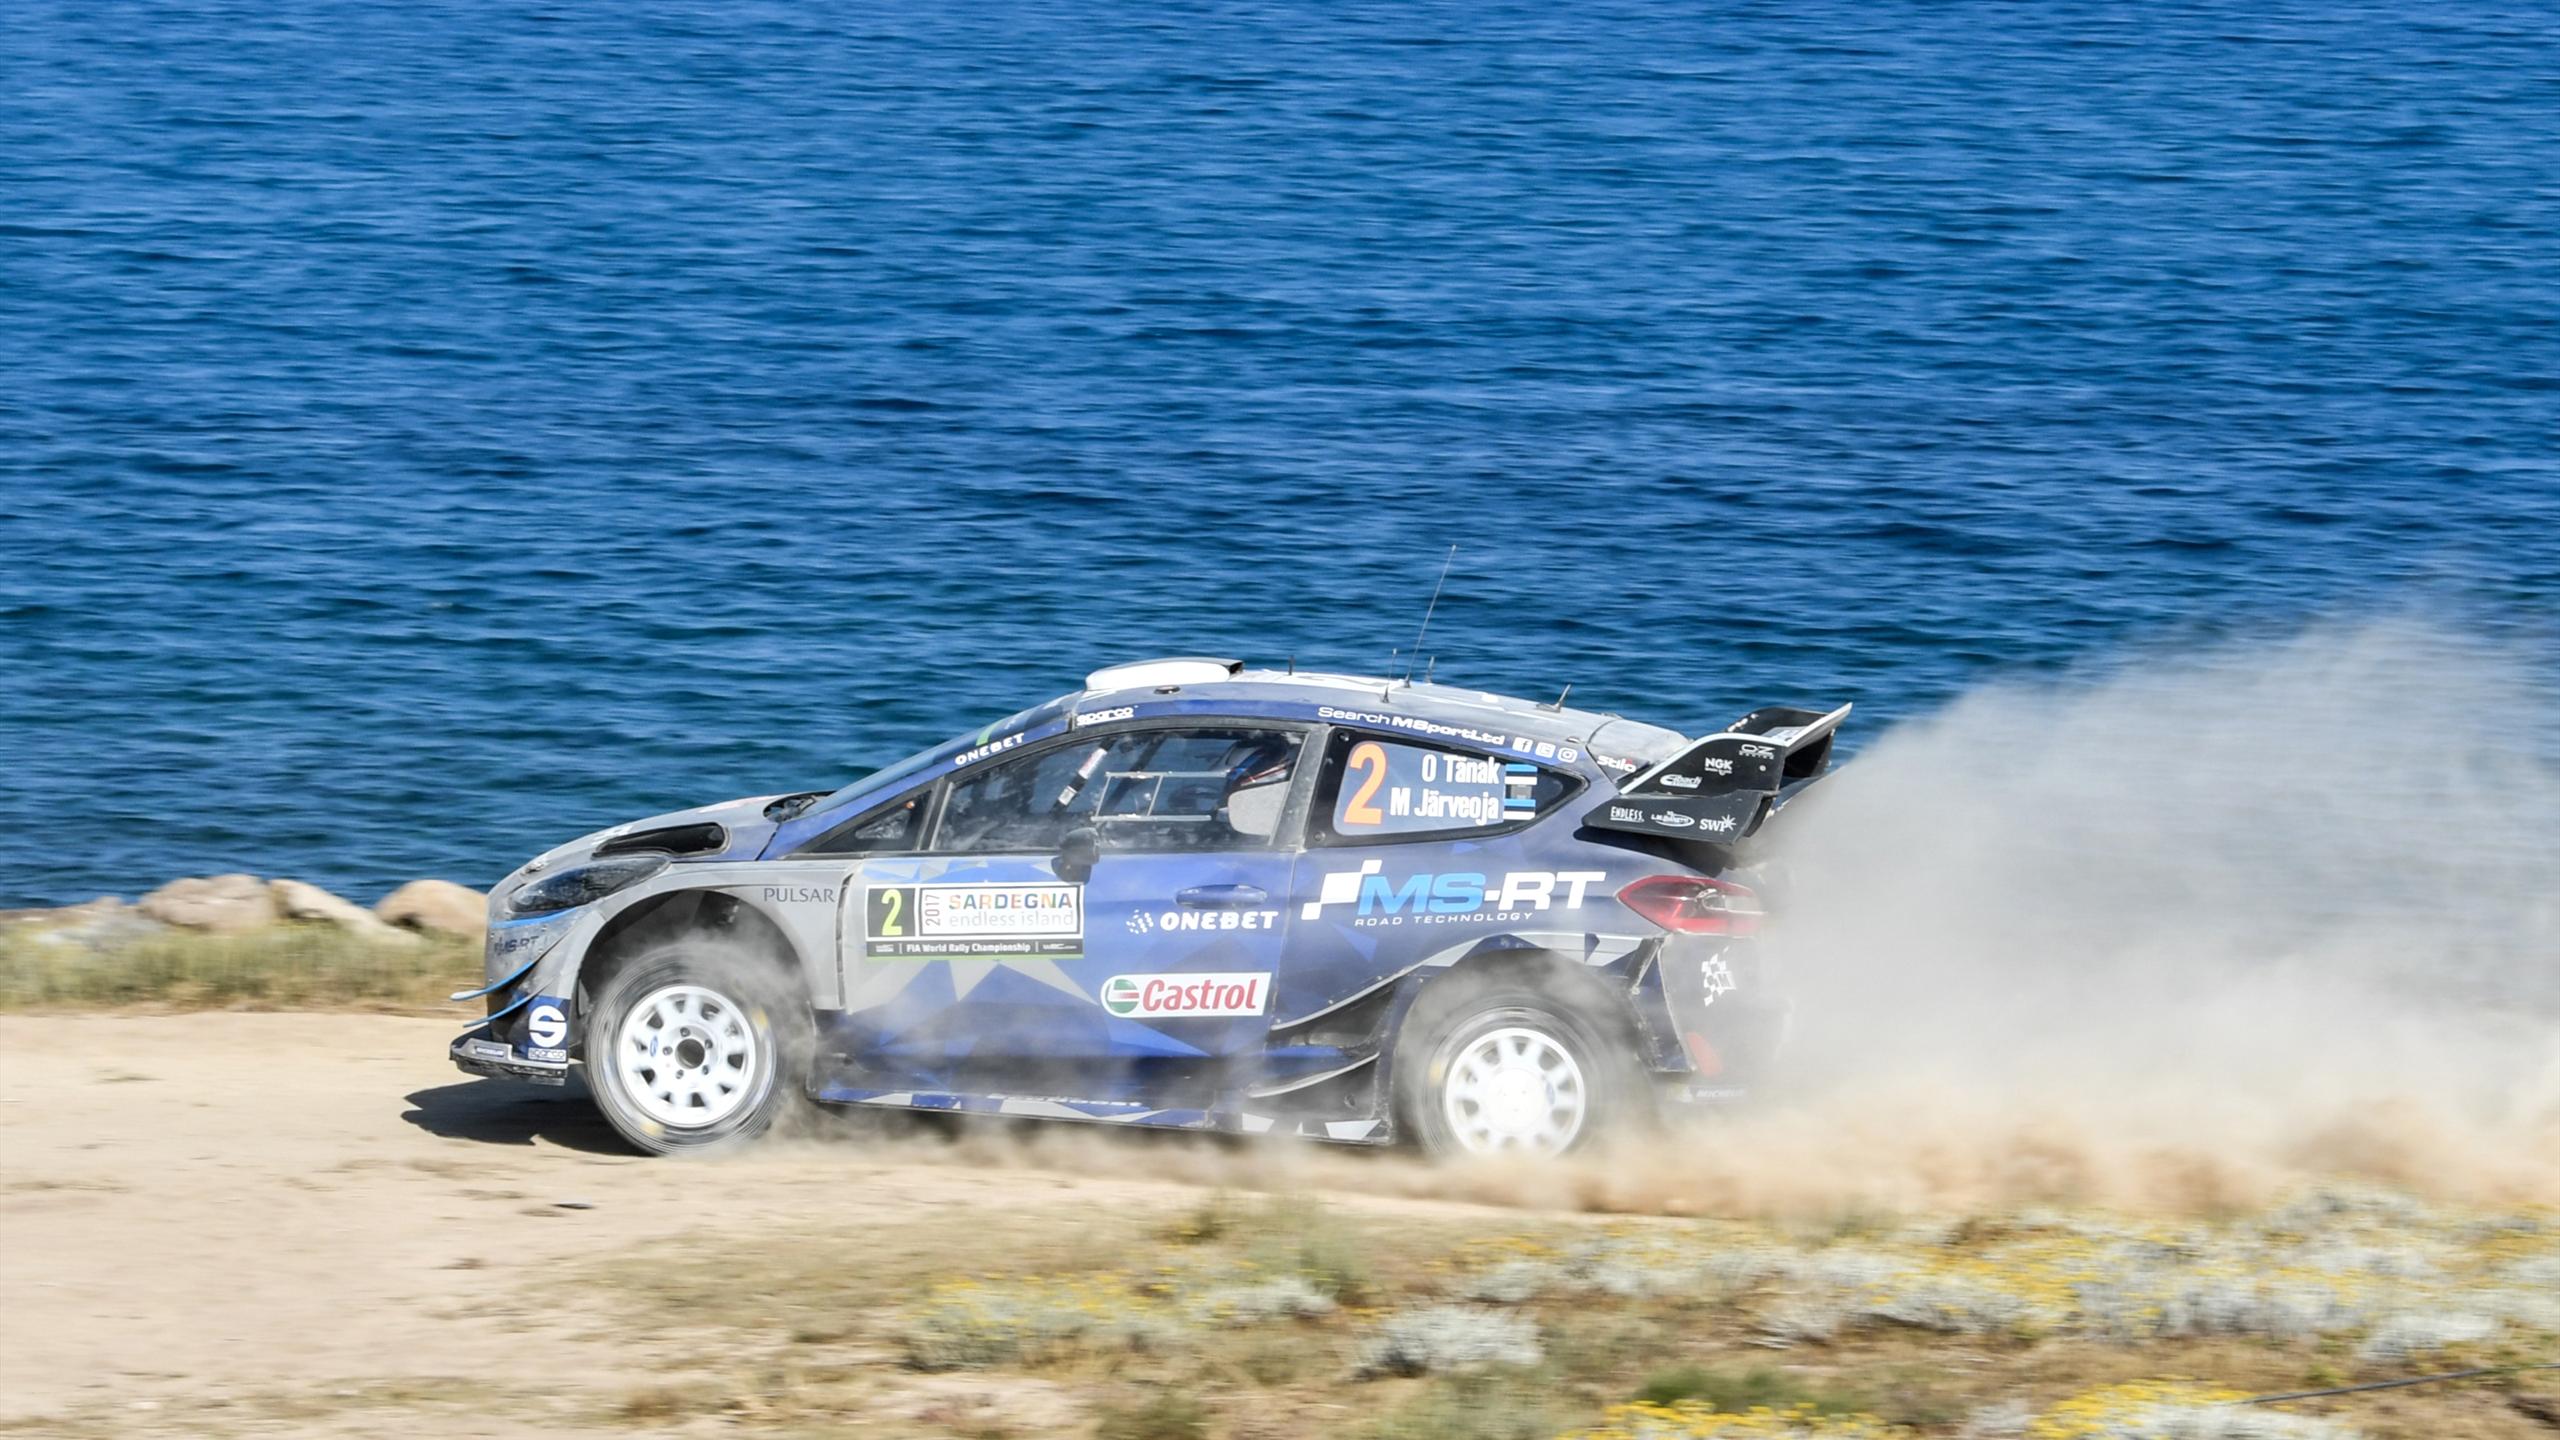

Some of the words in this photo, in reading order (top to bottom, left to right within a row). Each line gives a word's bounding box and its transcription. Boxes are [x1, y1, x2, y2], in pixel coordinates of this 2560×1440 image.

[1318, 706, 1391, 725] Search
[954, 732, 1025, 766] ONEBET
[1421, 753, 1437, 783] O
[1705, 757, 1733, 770] NGK
[1343, 742, 1387, 825] 2
[1390, 787, 1411, 816] M
[1414, 787, 1499, 827] Järveoja
[763, 887, 836, 903] PULSAR
[948, 892, 1073, 910] SARDEGNA
[1357, 871, 1607, 916] MS-RT
[881, 888, 904, 937] 2
[924, 894, 941, 927] 2017
[949, 911, 1017, 928] endless
[1020, 910, 1075, 926] island
[1160, 910, 1280, 931] ONEBET
[1354, 916, 1404, 927] ROAD
[1413, 911, 1534, 925] TECHNOLOGY
[906, 943, 921, 953] FIA
[922, 943, 947, 953] World
[948, 943, 970, 954] Rally
[971, 942, 1031, 954] Championship
[1142, 977, 1258, 1012] Castrol
